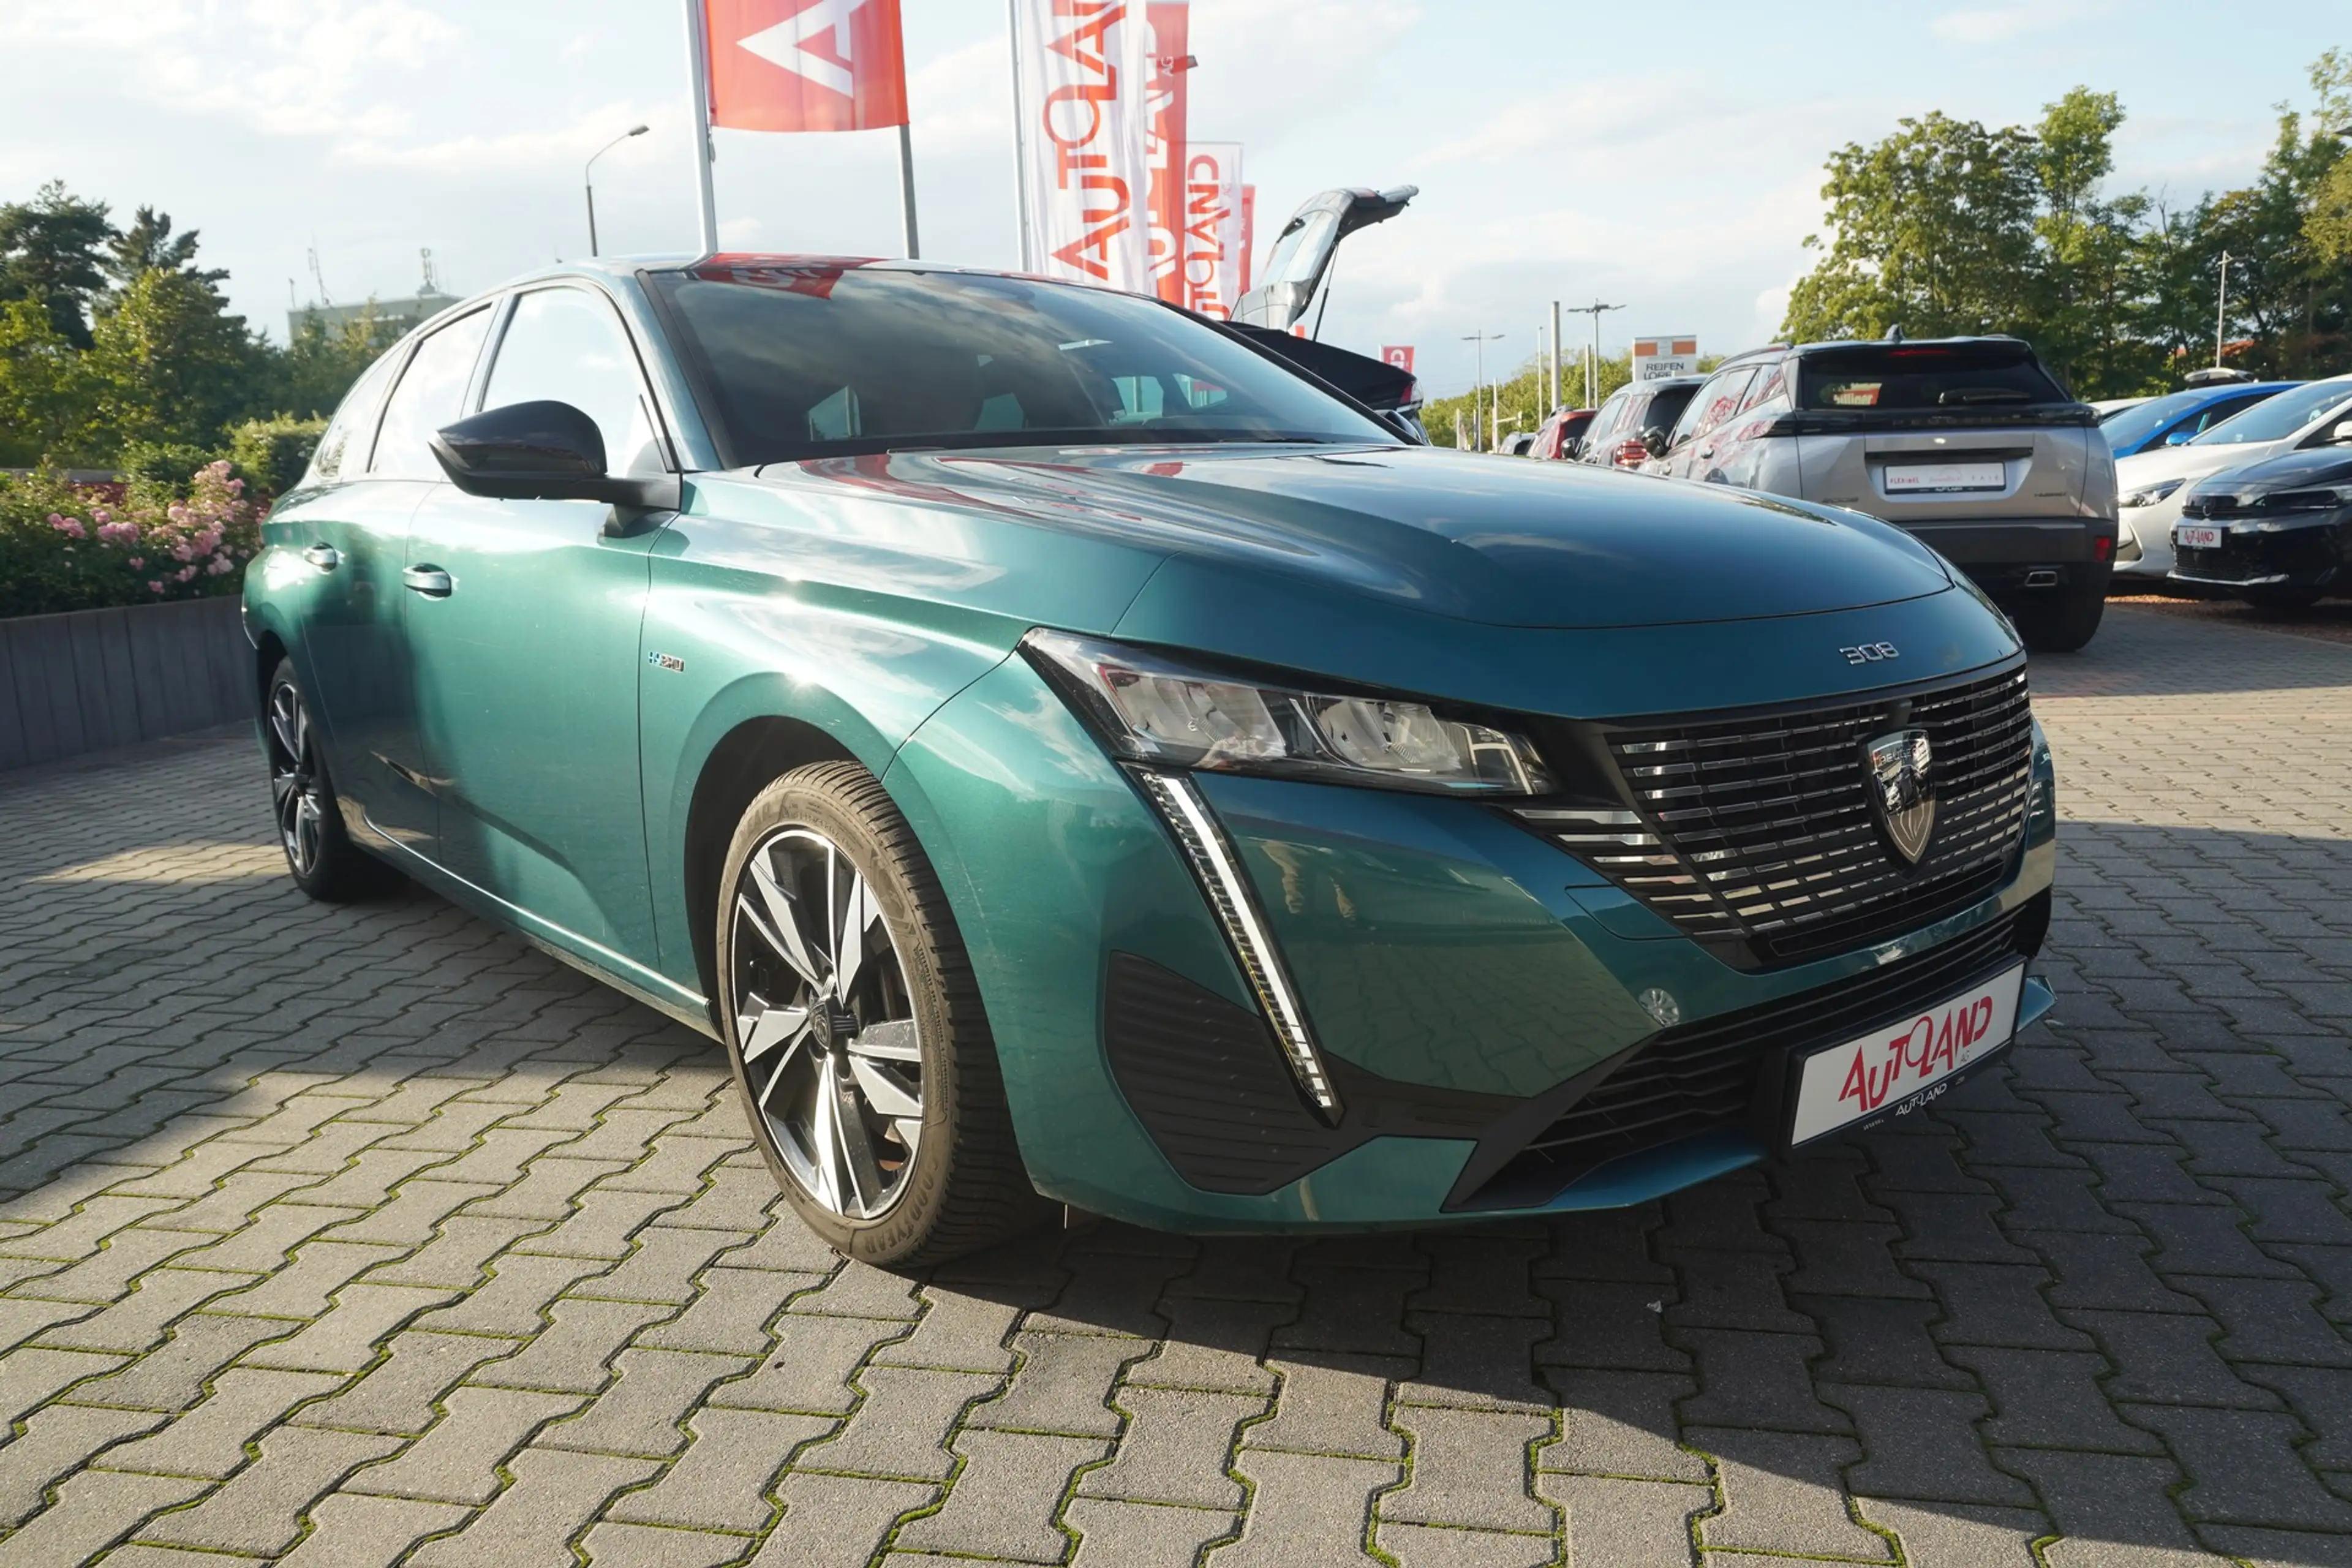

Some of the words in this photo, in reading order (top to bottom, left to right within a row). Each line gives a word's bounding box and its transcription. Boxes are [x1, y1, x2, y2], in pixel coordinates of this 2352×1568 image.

[1839, 641, 1899, 665] 308
[1838, 996, 1993, 1112] AUTOLAND
[1895, 1082, 1947, 1117] AUTOLAND
